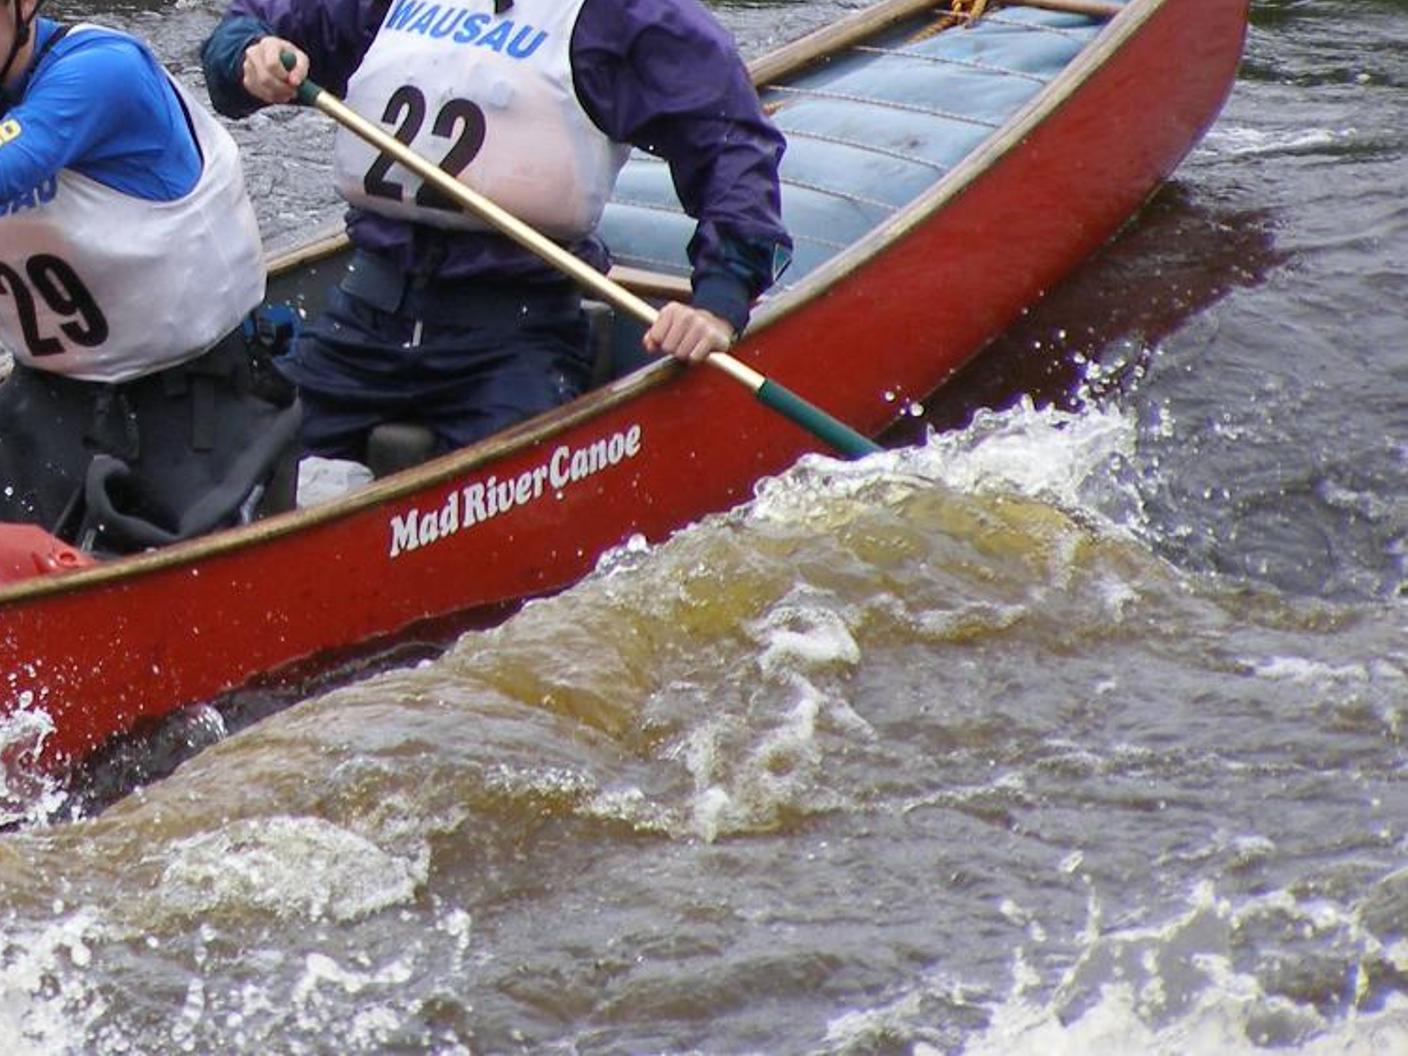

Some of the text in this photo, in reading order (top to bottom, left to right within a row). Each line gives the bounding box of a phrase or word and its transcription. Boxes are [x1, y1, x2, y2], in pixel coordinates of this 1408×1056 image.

[364, 84, 486, 213] 22
[390, 424, 641, 558] Mad River Canoe
